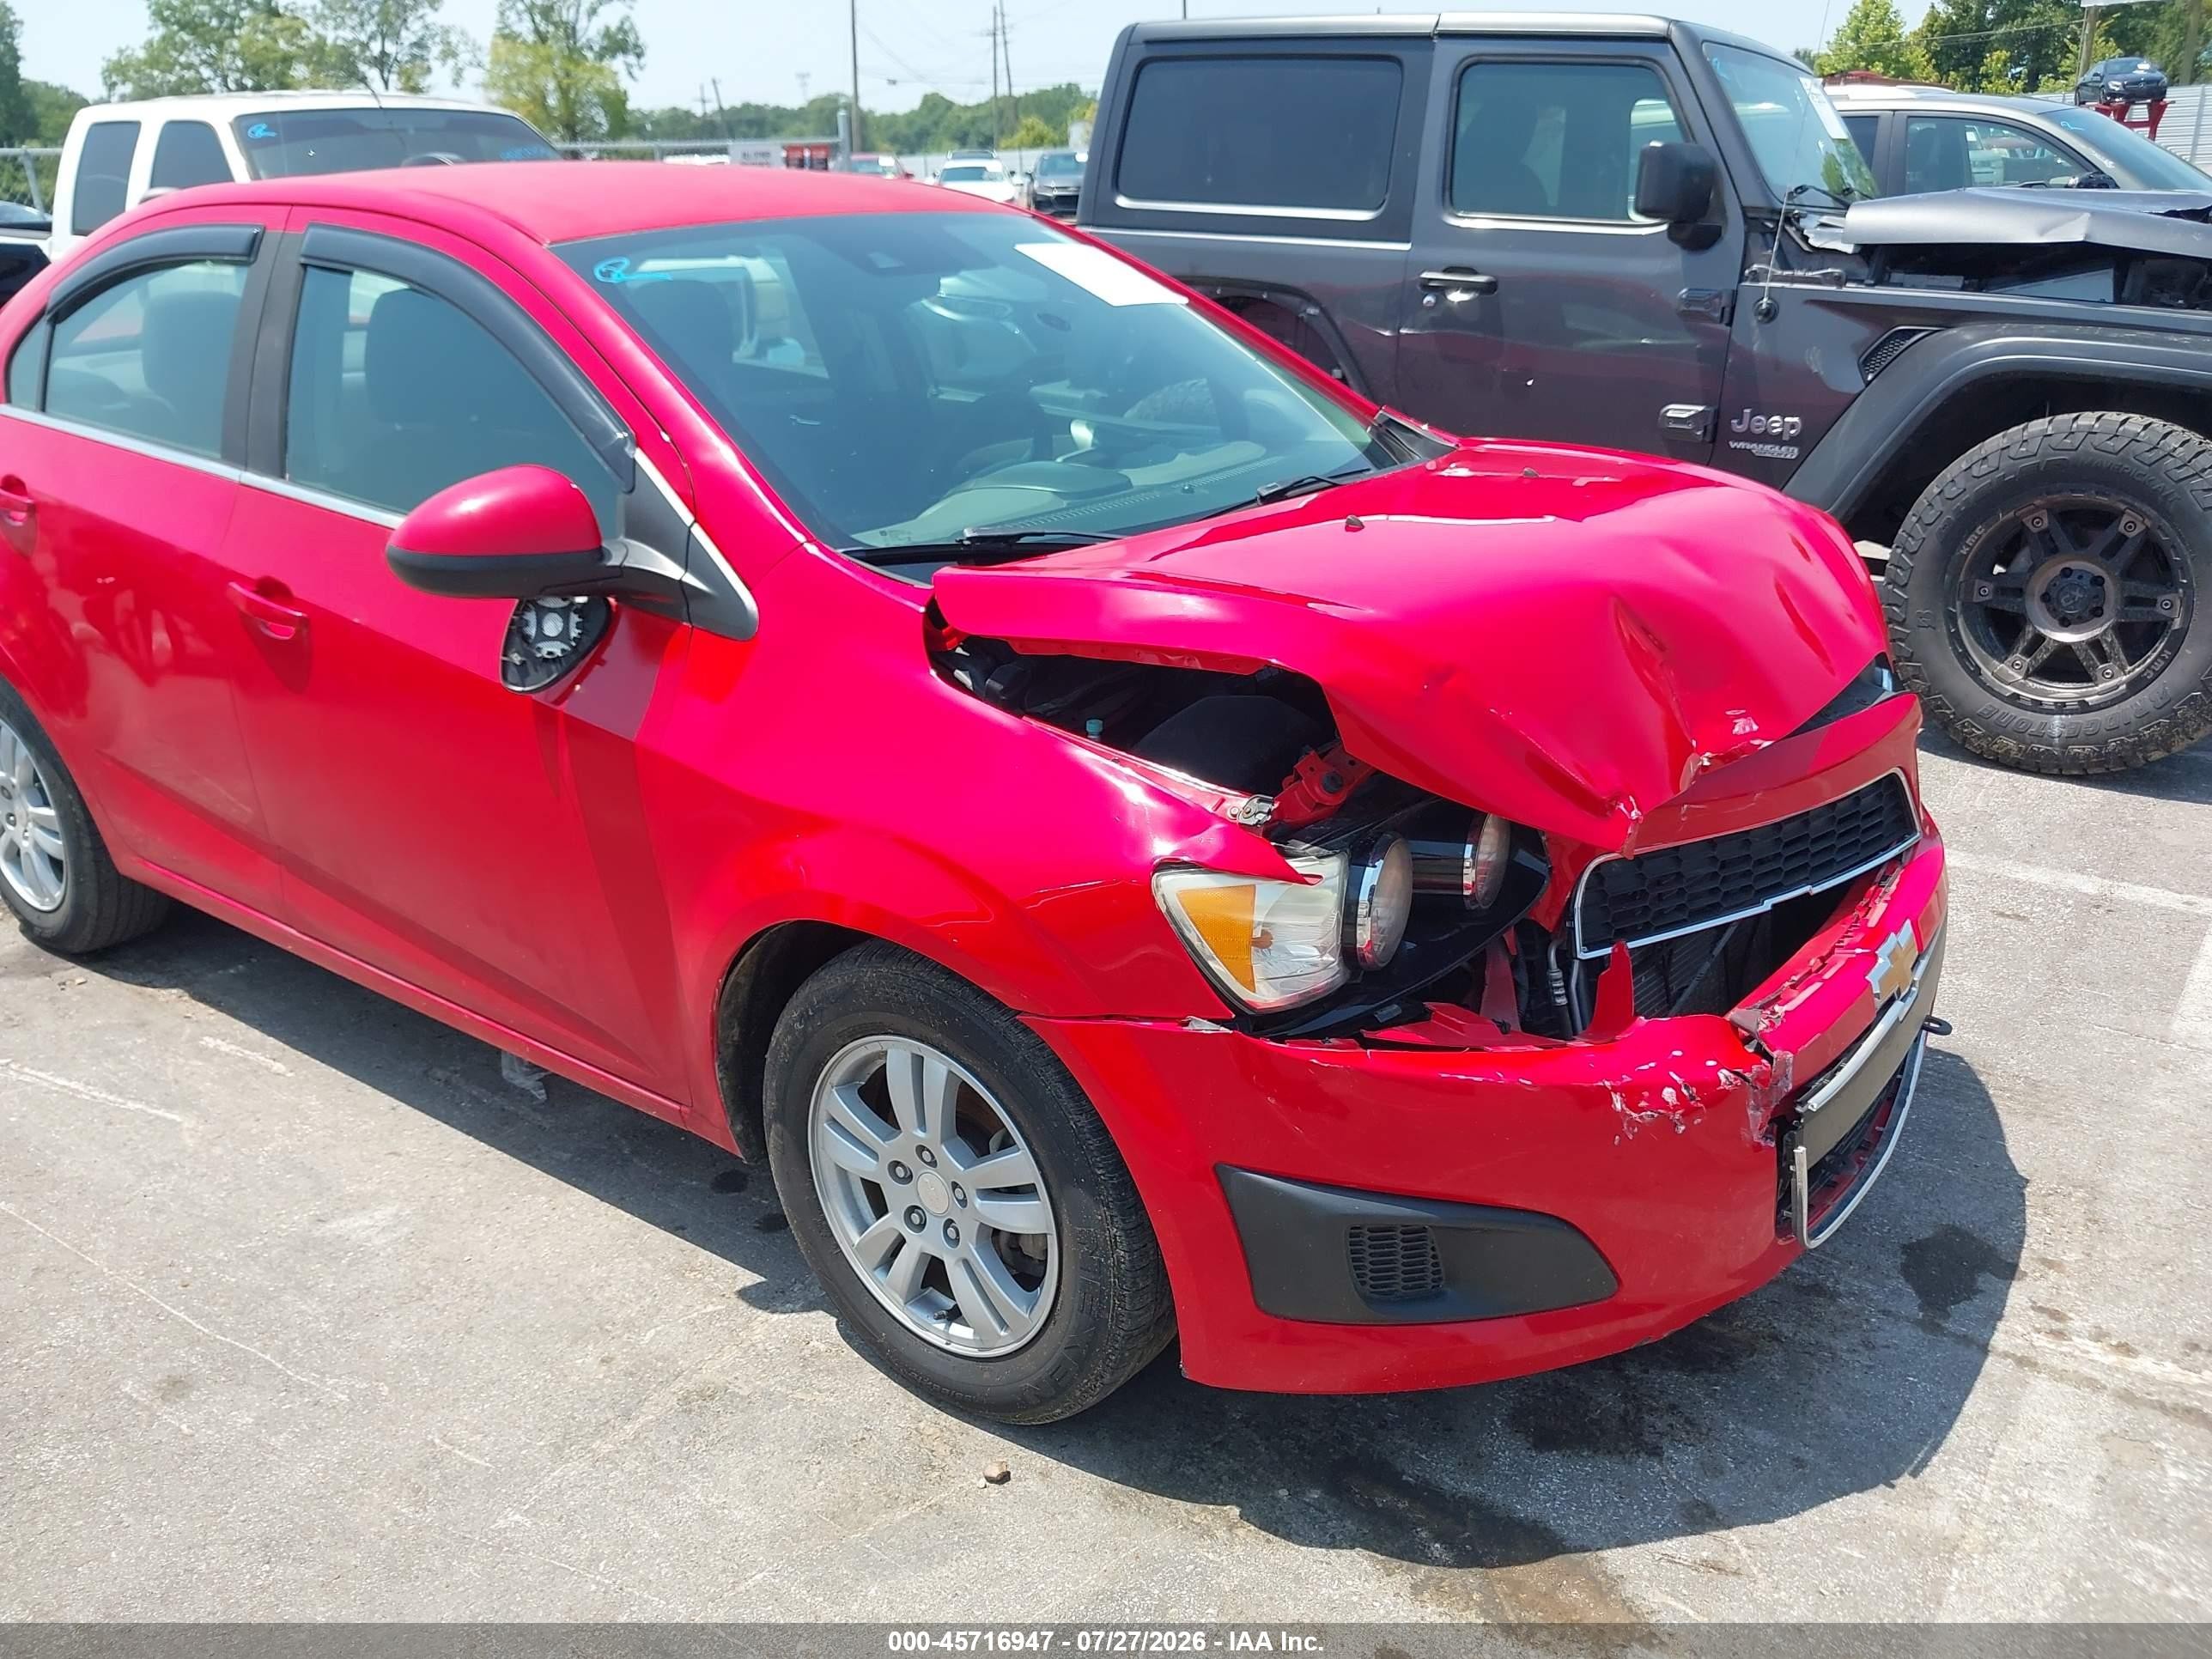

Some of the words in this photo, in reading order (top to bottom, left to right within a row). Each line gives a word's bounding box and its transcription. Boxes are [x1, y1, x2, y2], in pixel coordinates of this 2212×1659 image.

[1730, 407, 1802, 441] Jeep
[1729, 441, 1799, 455] WRANGLER
[1977, 682, 2172, 738] BRIDGESTONE
